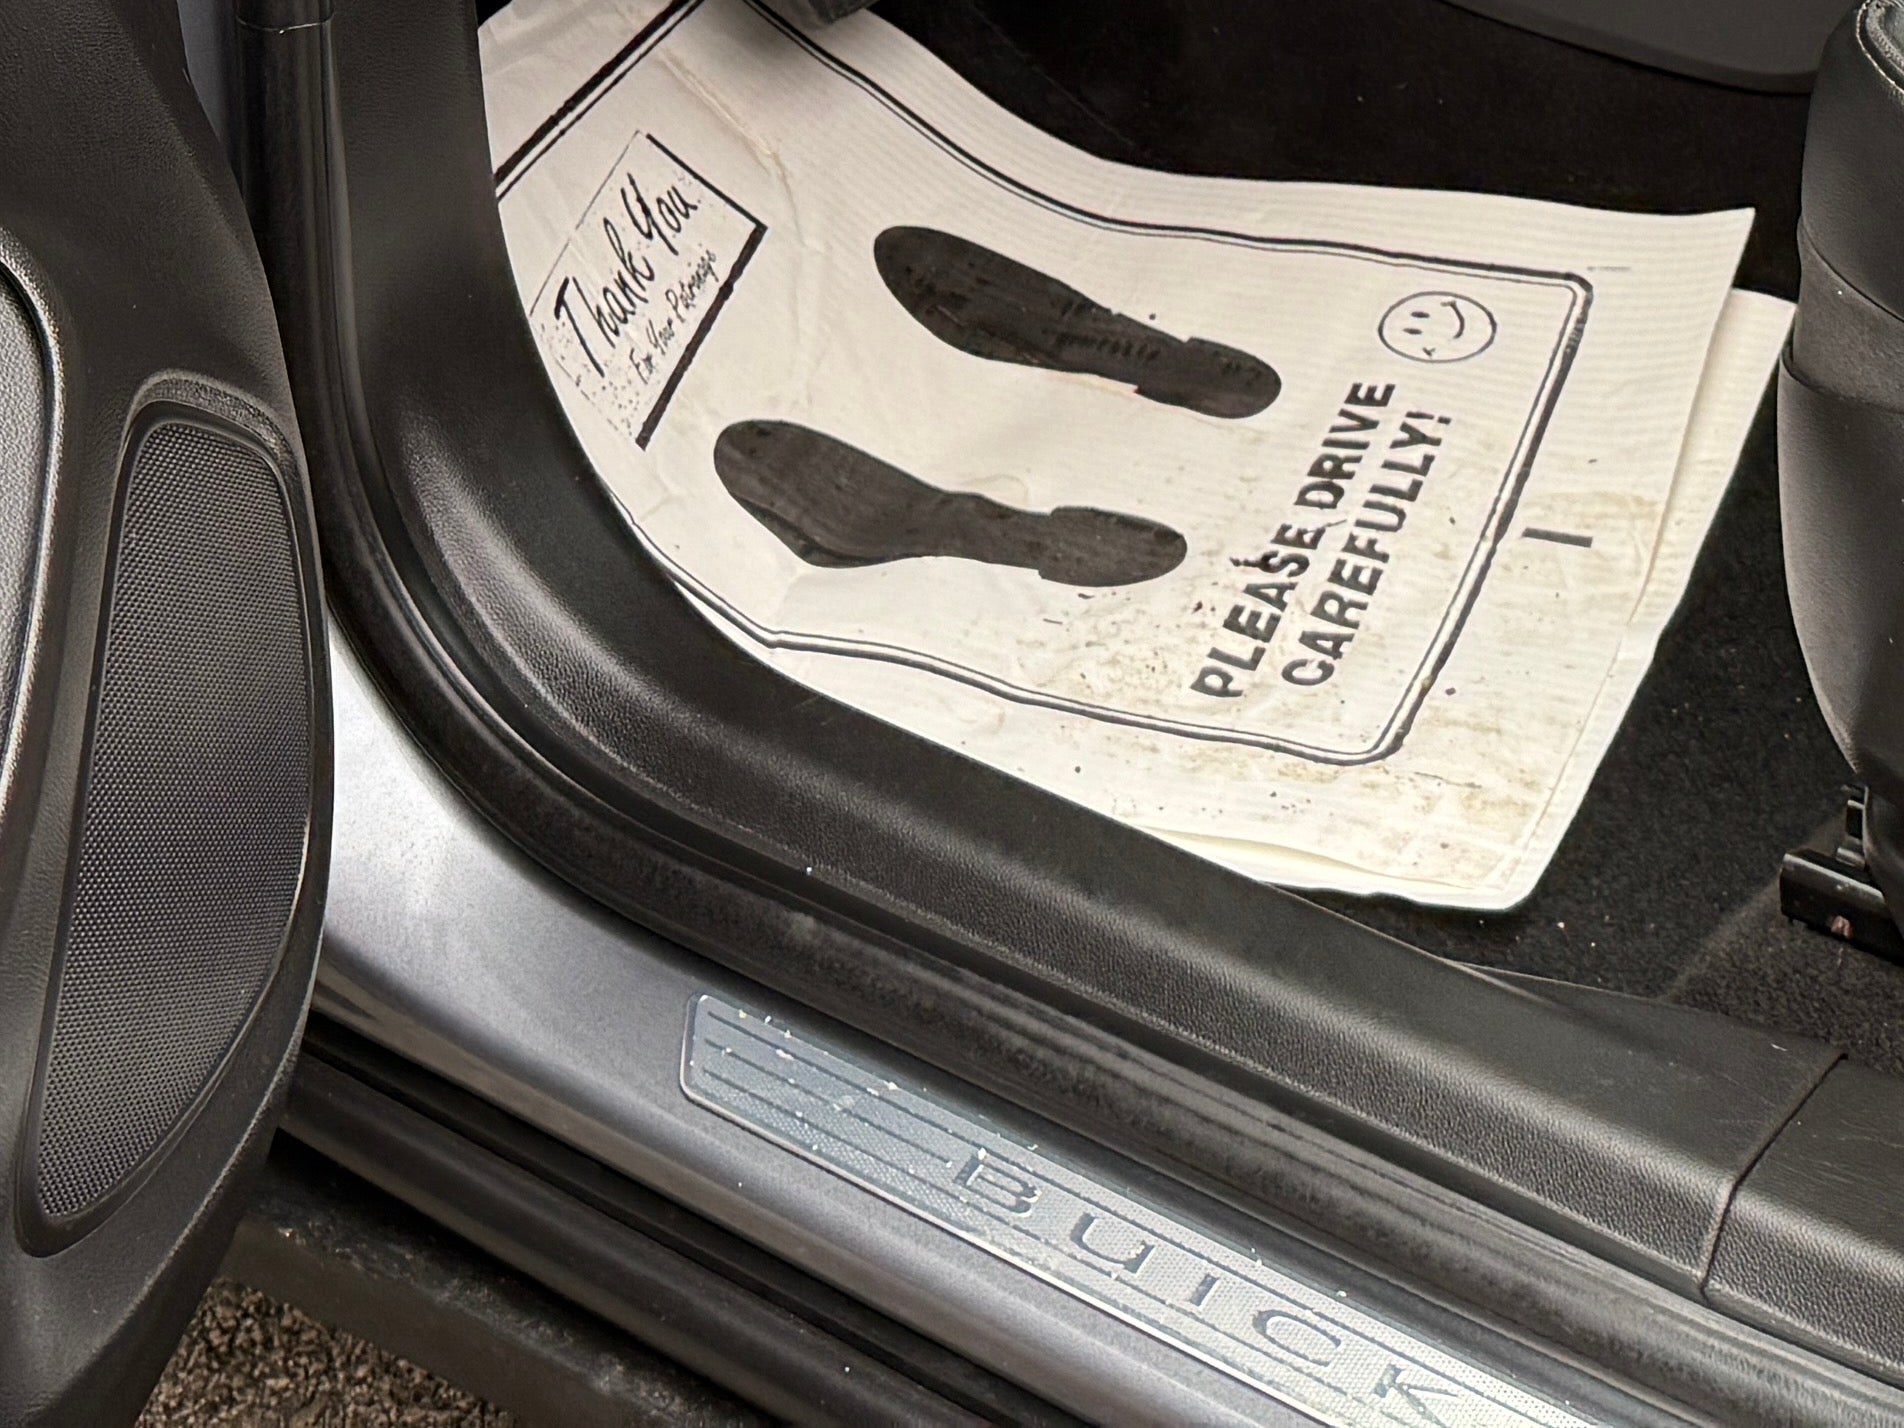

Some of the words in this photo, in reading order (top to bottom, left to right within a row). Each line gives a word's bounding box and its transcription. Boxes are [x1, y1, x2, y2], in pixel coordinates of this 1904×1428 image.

[554, 217, 655, 378] Thank
[621, 172, 698, 256] You
[1190, 521, 1326, 699] PLEASE
[1295, 382, 1396, 511] DRIVE
[1281, 410, 1452, 686] CAREFULLY!
[953, 1147, 1459, 1428] BUICK
